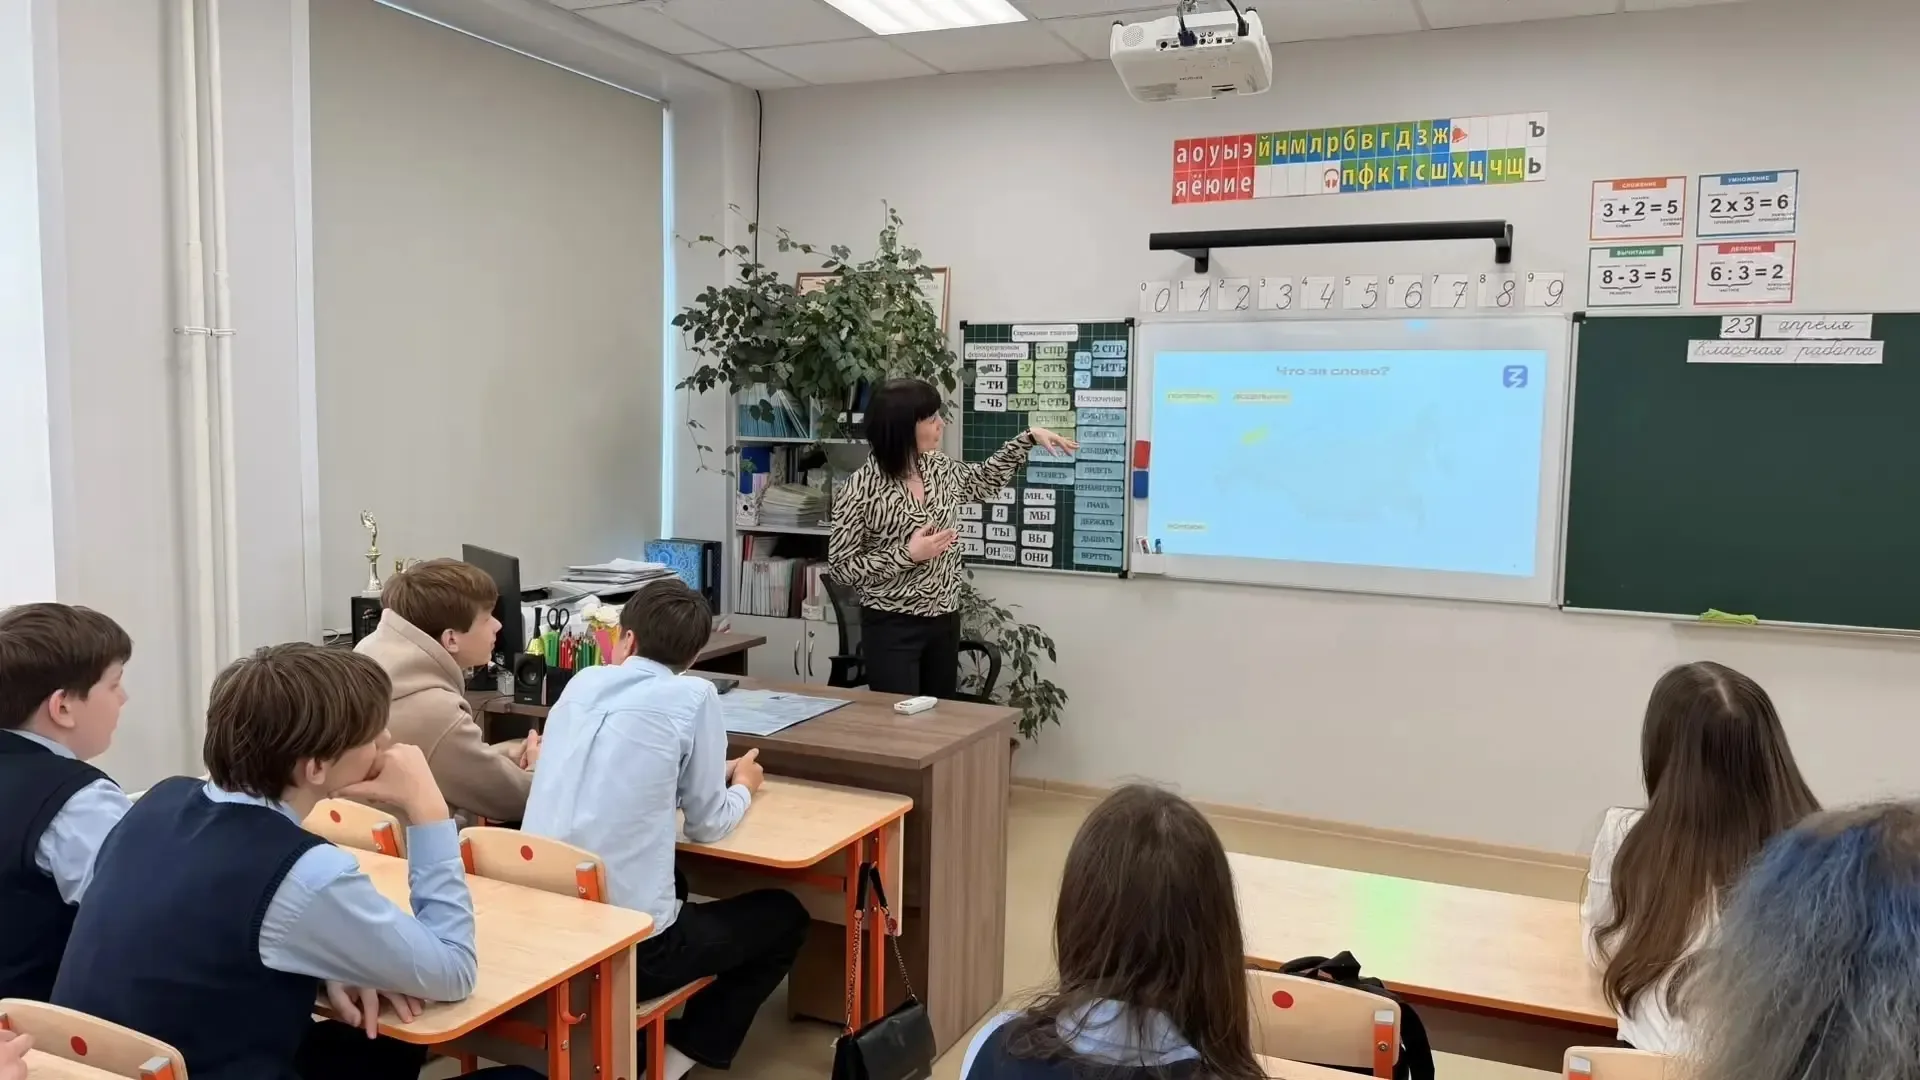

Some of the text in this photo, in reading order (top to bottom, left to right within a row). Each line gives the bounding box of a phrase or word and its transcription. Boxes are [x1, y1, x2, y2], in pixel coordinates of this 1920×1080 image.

[1728, 175, 1770, 183] УМНОЖЕНИЕ
[1603, 200, 1678, 217] 3 + 2 = 5
[1710, 198, 1722, 213] 2
[1743, 196, 1754, 211] 3
[1760, 199, 1772, 207] =
[1777, 194, 1789, 209] 6
[1602, 270, 1613, 284] 8
[1629, 269, 1640, 283] 3
[1661, 268, 1672, 282] 5
[1711, 266, 1722, 281] 6
[1738, 265, 1749, 280] 3
[1755, 268, 1767, 276] =
[1772, 264, 1783, 279] 2
[1140, 282, 1170, 312] 0 0
[1180, 281, 1210, 311] 1 1
[1219, 279, 1250, 311] 2 2
[1260, 279, 1292, 309] 3 3
[1301, 276, 1335, 309] 4 4
[1344, 276, 1378, 308] 5 5
[1388, 275, 1422, 308] 6 6
[1433, 275, 1468, 307] 7 7
[1479, 274, 1516, 307] 8 8
[1527, 272, 1564, 307] 9 9
[1725, 317, 1854, 338] 23 апреля
[1037, 346, 1067, 357] 1 спр.
[1093, 344, 1126, 355] 2 спр.
[1694, 340, 1876, 362] Классная работа
[1092, 363, 1125, 372] -ить
[1276, 365, 1306, 375] Что
[1331, 366, 1391, 376] слово?
[980, 398, 1003, 407] -чь
[1009, 397, 1038, 409] -уть
[959, 507, 964, 515] 1
[958, 524, 964, 533] 2
